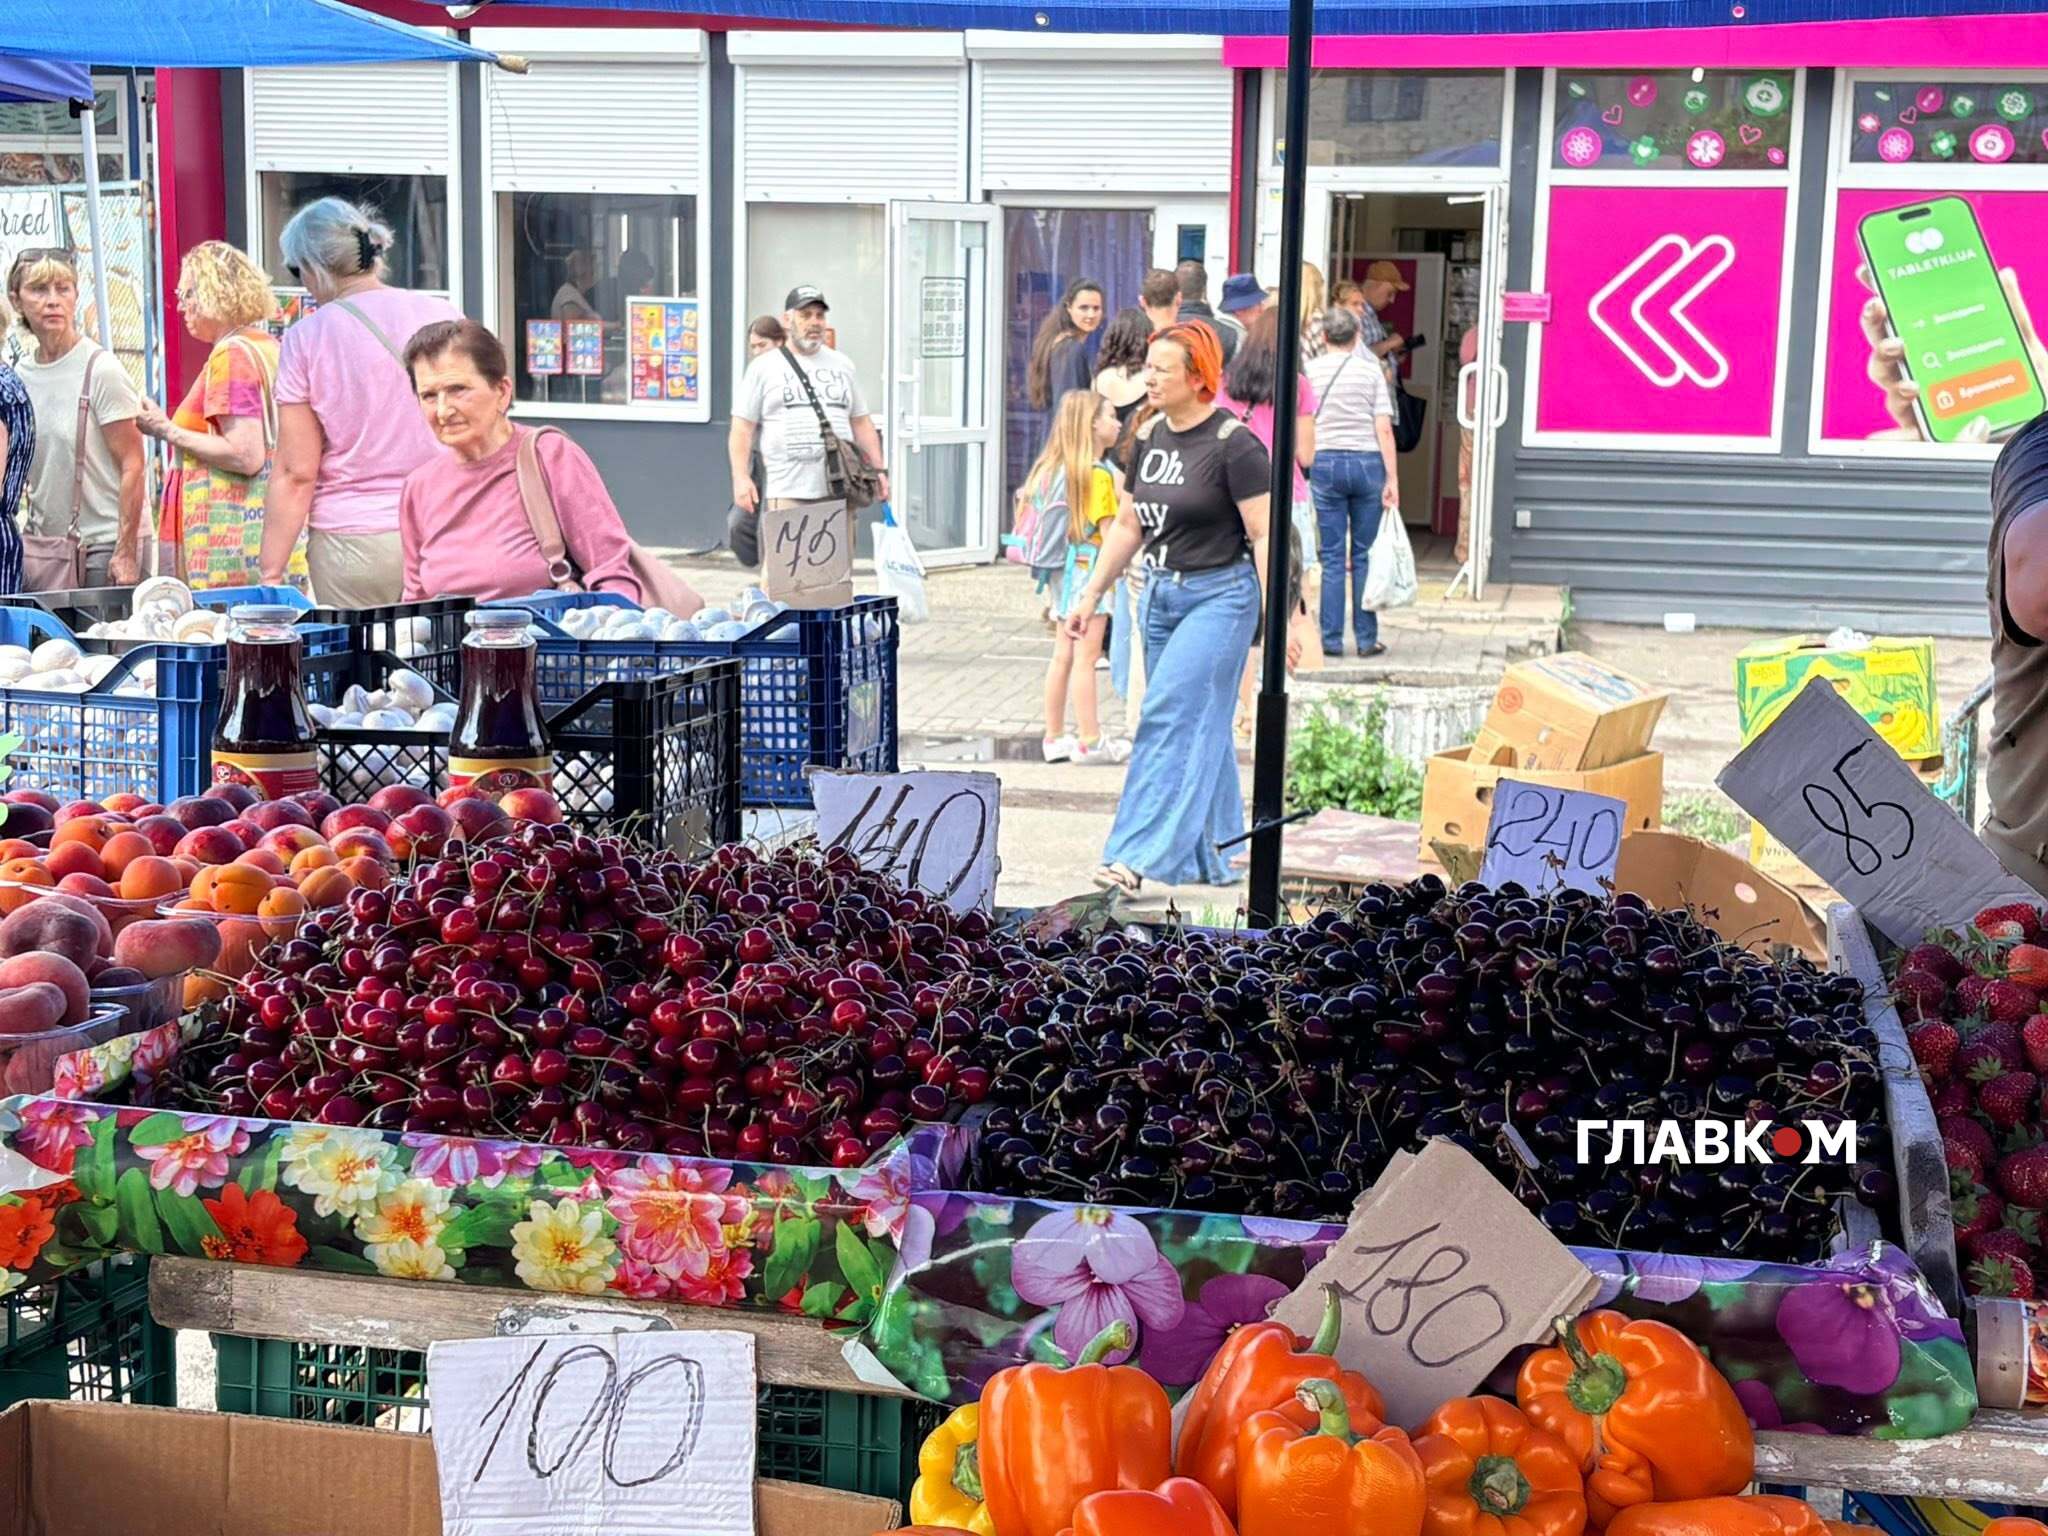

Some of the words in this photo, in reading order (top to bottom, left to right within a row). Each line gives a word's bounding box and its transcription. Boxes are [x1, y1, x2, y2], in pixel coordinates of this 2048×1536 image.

[1140, 448, 1184, 485] Oh.
[823, 784, 986, 898] 140
[1488, 790, 1618, 870] 240
[1802, 738, 1914, 876] 85
[1334, 1222, 1511, 1368] 180
[474, 1339, 705, 1487] 100
